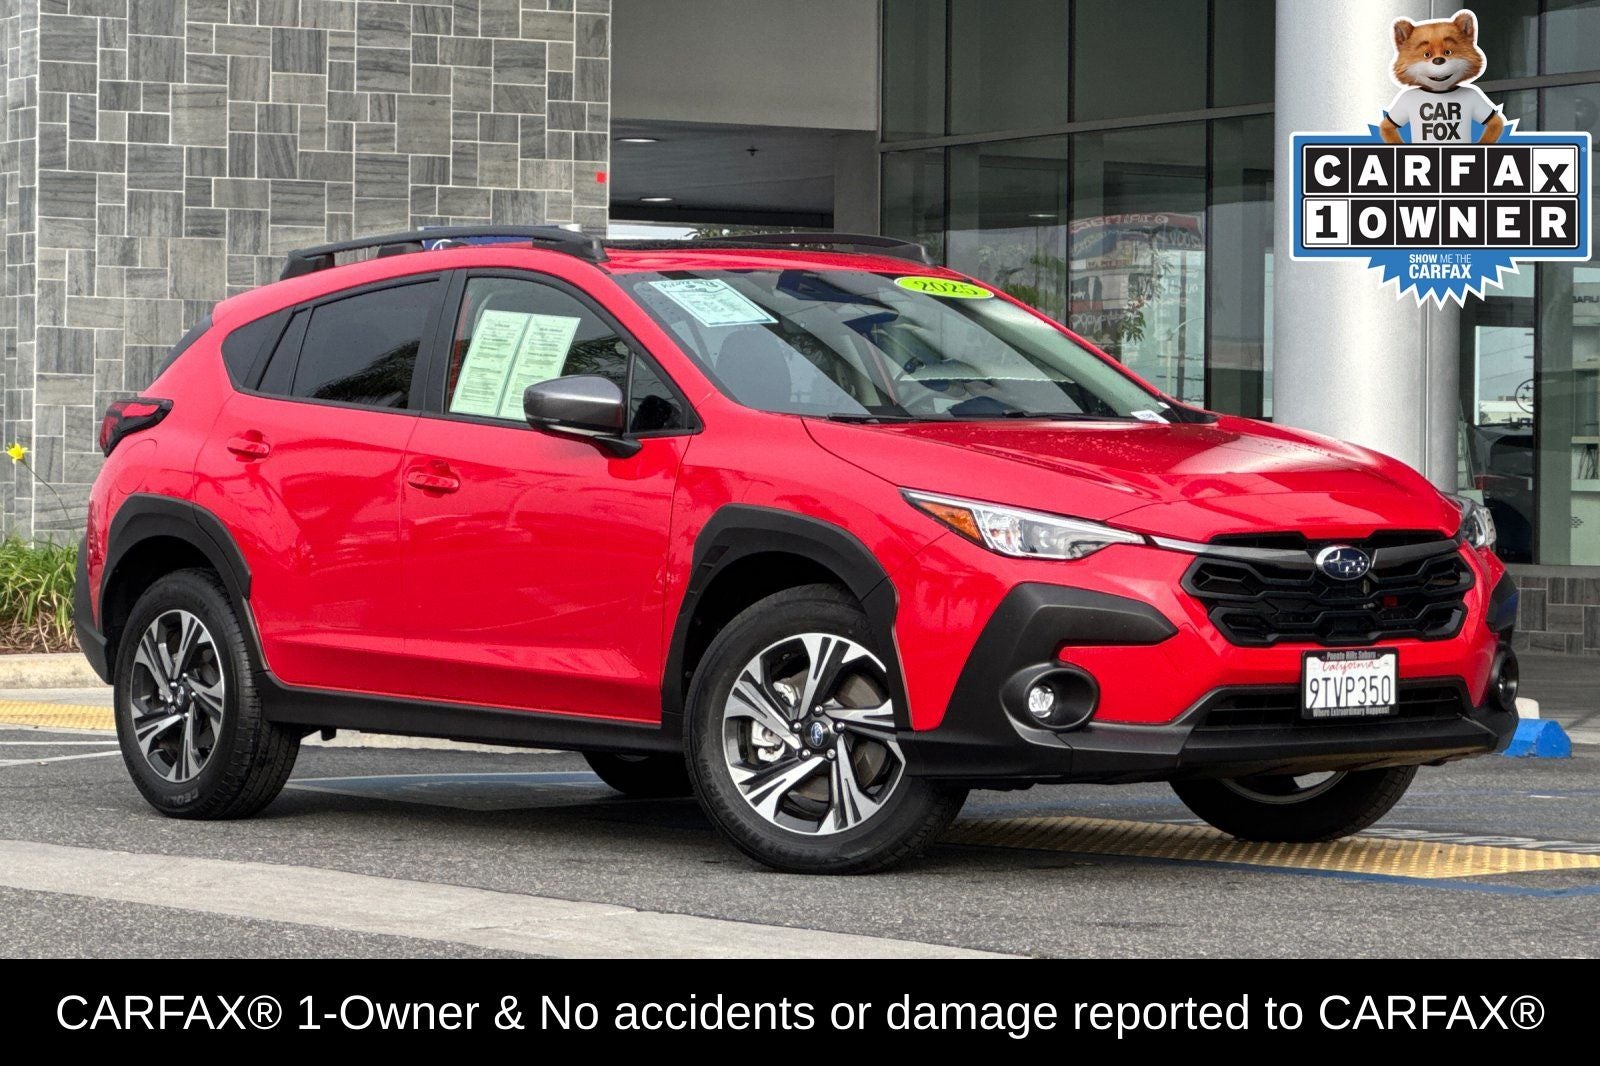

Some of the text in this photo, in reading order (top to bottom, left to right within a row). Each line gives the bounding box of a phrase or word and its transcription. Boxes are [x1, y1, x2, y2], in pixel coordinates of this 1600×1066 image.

[913, 280, 979, 296] 2025
[1322, 660, 1376, 675] California
[1309, 675, 1391, 709] 9TVP350
